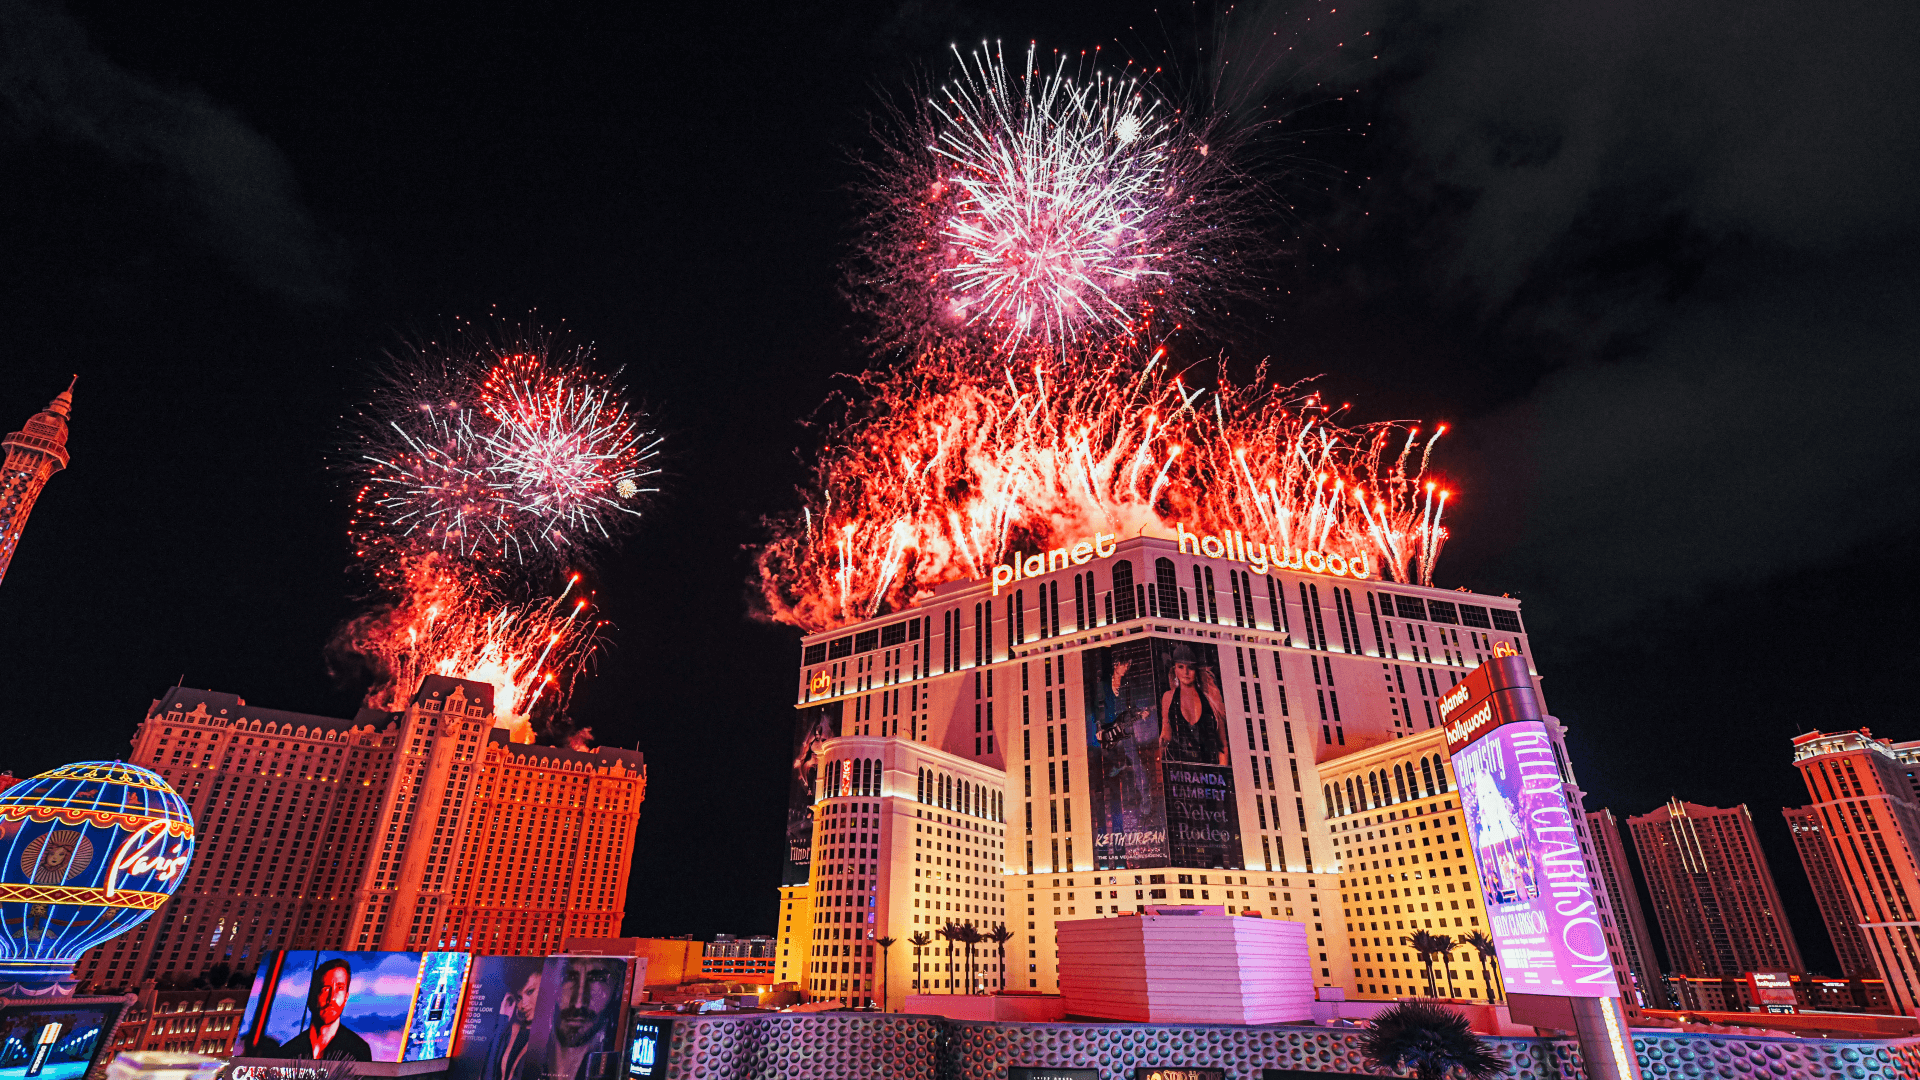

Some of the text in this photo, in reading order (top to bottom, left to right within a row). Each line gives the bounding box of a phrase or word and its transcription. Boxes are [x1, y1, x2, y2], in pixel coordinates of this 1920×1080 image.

[992, 522, 1371, 597] planet hollywood
[812, 670, 831, 693] ph
[1440, 684, 1469, 723] planet
[1445, 700, 1492, 746] hollywood
[1170, 770, 1227, 787] MIRANDA
[1457, 734, 1506, 789] chemistry
[1511, 731, 1566, 803] KELLY
[1172, 785, 1226, 802] LAMBERT
[1174, 801, 1229, 823] Velvet
[1095, 832, 1128, 848] KEITH
[1128, 828, 1166, 846] URBAN
[1178, 823, 1231, 843] Rodeo
[106, 818, 188, 898] Paris
[1531, 806, 1618, 985] CLARKSON
